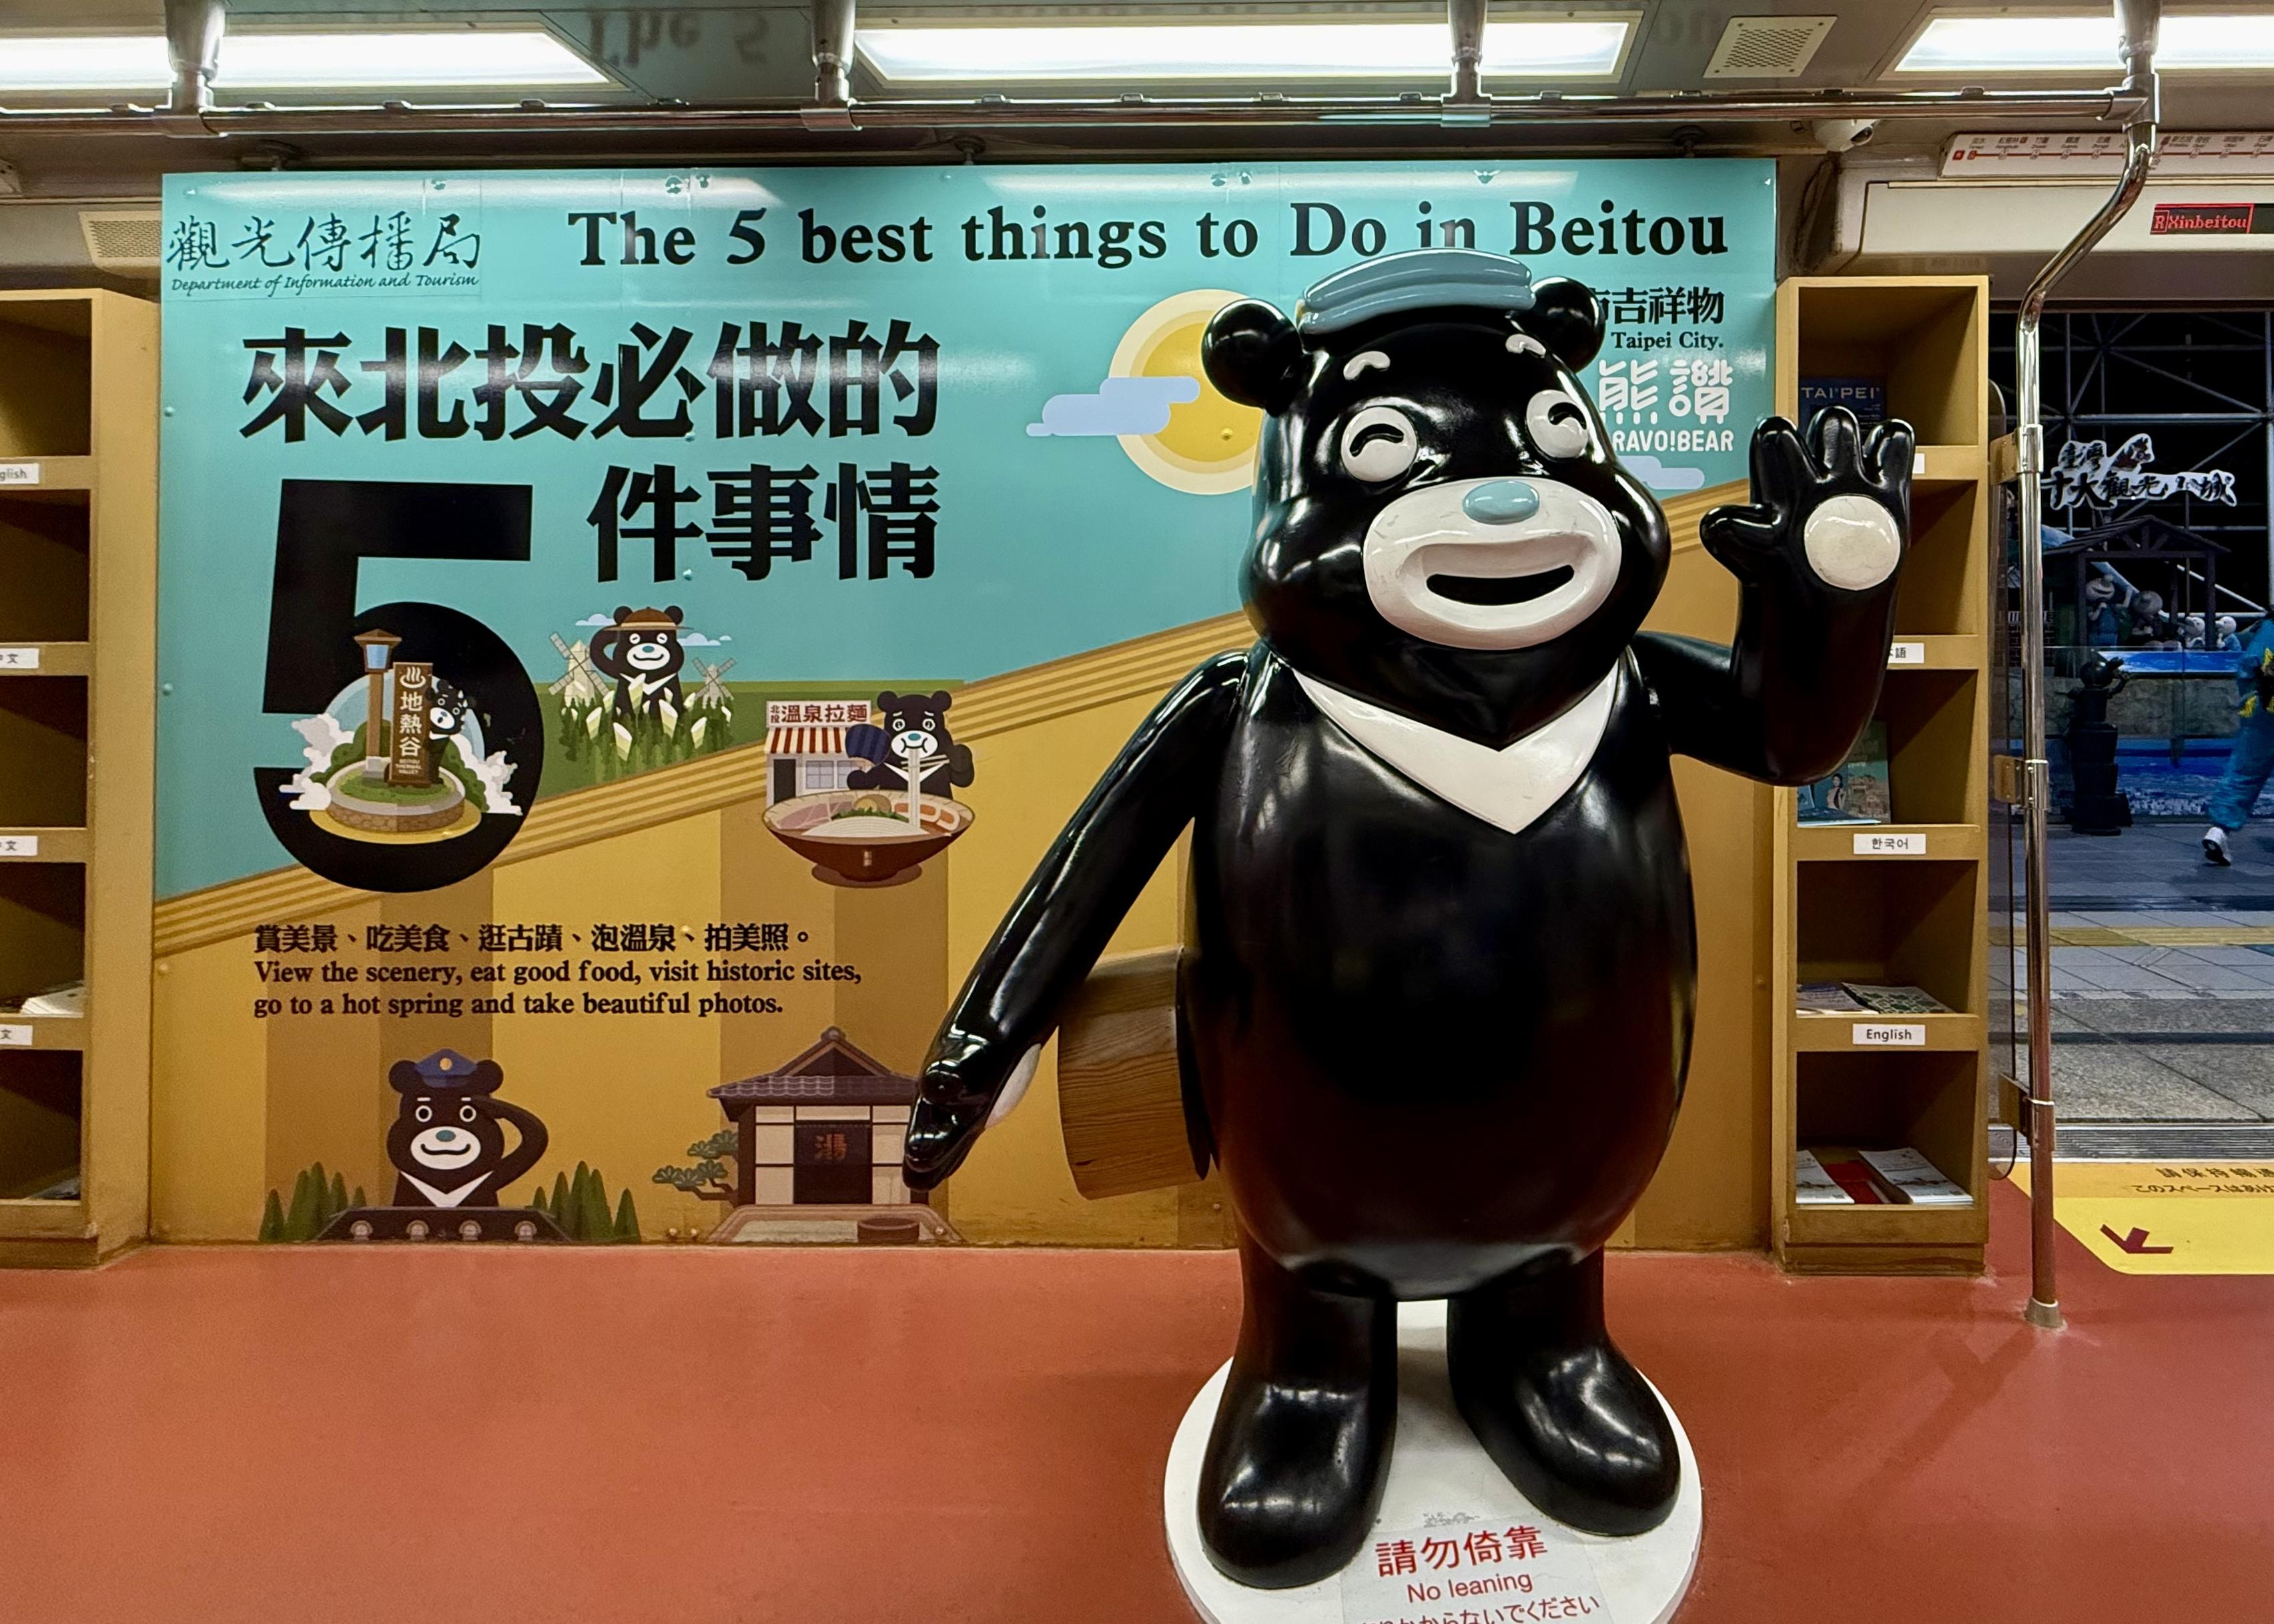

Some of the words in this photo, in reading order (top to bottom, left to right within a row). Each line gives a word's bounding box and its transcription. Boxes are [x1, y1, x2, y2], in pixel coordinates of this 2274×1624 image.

[569, 212, 696, 266] The
[727, 209, 767, 265] 5
[799, 209, 933, 264] best
[962, 206, 1166, 270] things
[1198, 214, 1258, 258] to
[1291, 203, 1387, 257] Do
[1418, 201, 1475, 249] in
[1510, 199, 1728, 256] Beitou
[2168, 215, 2247, 229] Xinbeitou
[167, 211, 480, 272] 觀光傳播局
[172, 278, 262, 298] Department
[265, 275, 282, 297] of
[284, 275, 375, 295] Information
[378, 273, 411, 288] and
[416, 274, 479, 287] Tourism
[1611, 332, 1671, 352] Taipei
[1679, 332, 1724, 351] City.
[240, 320, 941, 444] 來北投必做的
[1612, 430, 1734, 452] RAVO!BEAR
[0, 468, 27, 482] glish
[587, 462, 941, 583] 件事情
[254, 479, 545, 893] 5
[400, 691, 422, 757] 地熱谷
[781, 705, 867, 723] 溫泉拉麵
[1872, 838, 1908, 849] 한국어
[254, 923, 809, 954] 賞美景、吃美食、逛古蹟、泡溫泉、拍美照。
[255, 960, 314, 983] View
[322, 961, 358, 983] the
[366, 967, 463, 986] scenery,
[471, 965, 506, 982] eat
[514, 960, 571, 985] good
[579, 959, 641, 985] food,
[649, 959, 700, 982] visit
[707, 959, 795, 982] historic
[803, 959, 862, 985] sites,
[254, 1000, 282, 1019] go
[291, 997, 313, 1016] to
[321, 1000, 335, 1015] a
[343, 993, 382, 1016] hot
[388, 992, 464, 1019] spring
[472, 993, 516, 1015] and
[524, 993, 575, 1014] take
[583, 992, 691, 1014] beautiful
[699, 993, 783, 1018] photos.
[1866, 1029, 1912, 1042] English
[1375, 1525, 1548, 1577] 請勿倚靠
[1407, 1583, 1441, 1603] No
[1448, 1573, 1533, 1599] leaning
